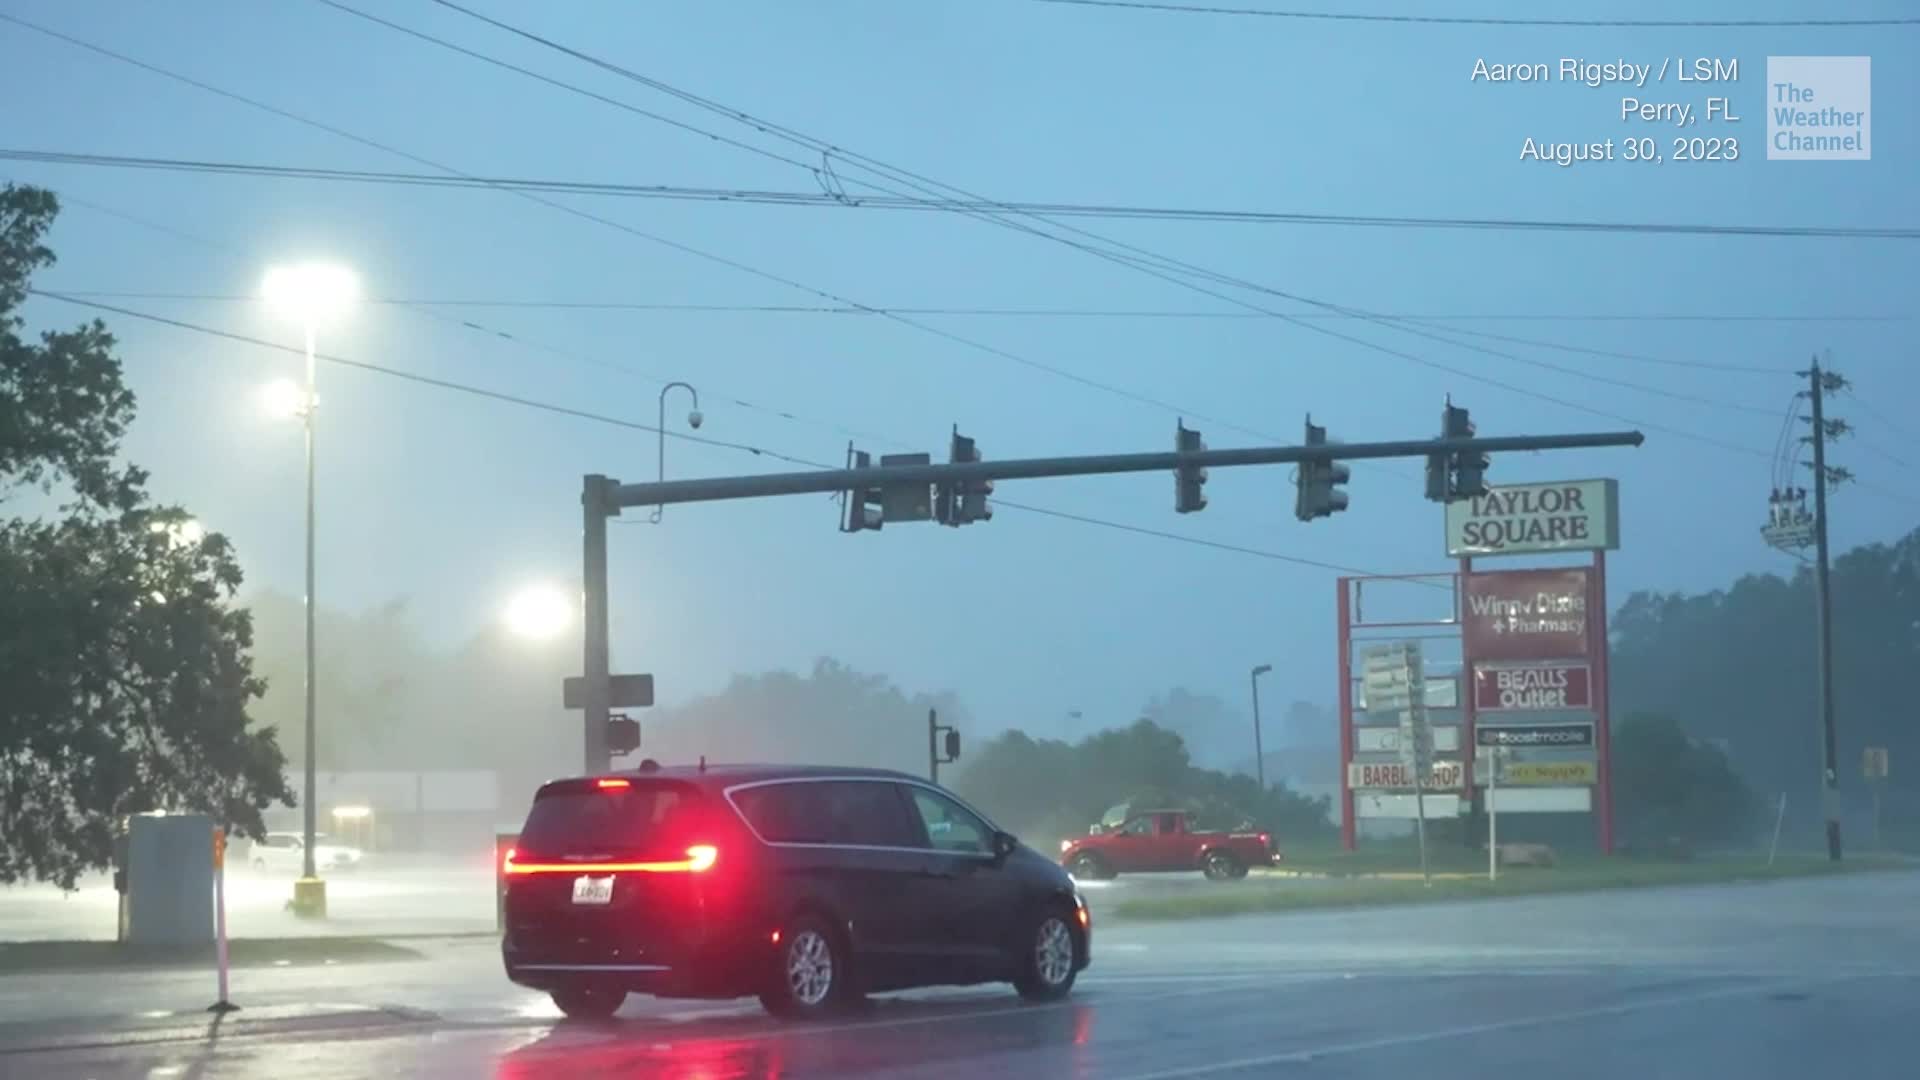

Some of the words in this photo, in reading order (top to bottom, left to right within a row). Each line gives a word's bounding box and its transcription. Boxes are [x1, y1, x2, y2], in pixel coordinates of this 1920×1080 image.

[1469, 487, 1585, 517] TAYLOR
[1462, 516, 1589, 548] SQUARE
[1508, 616, 1585, 635] Pharmacy
[1497, 670, 1568, 690] BEALLS
